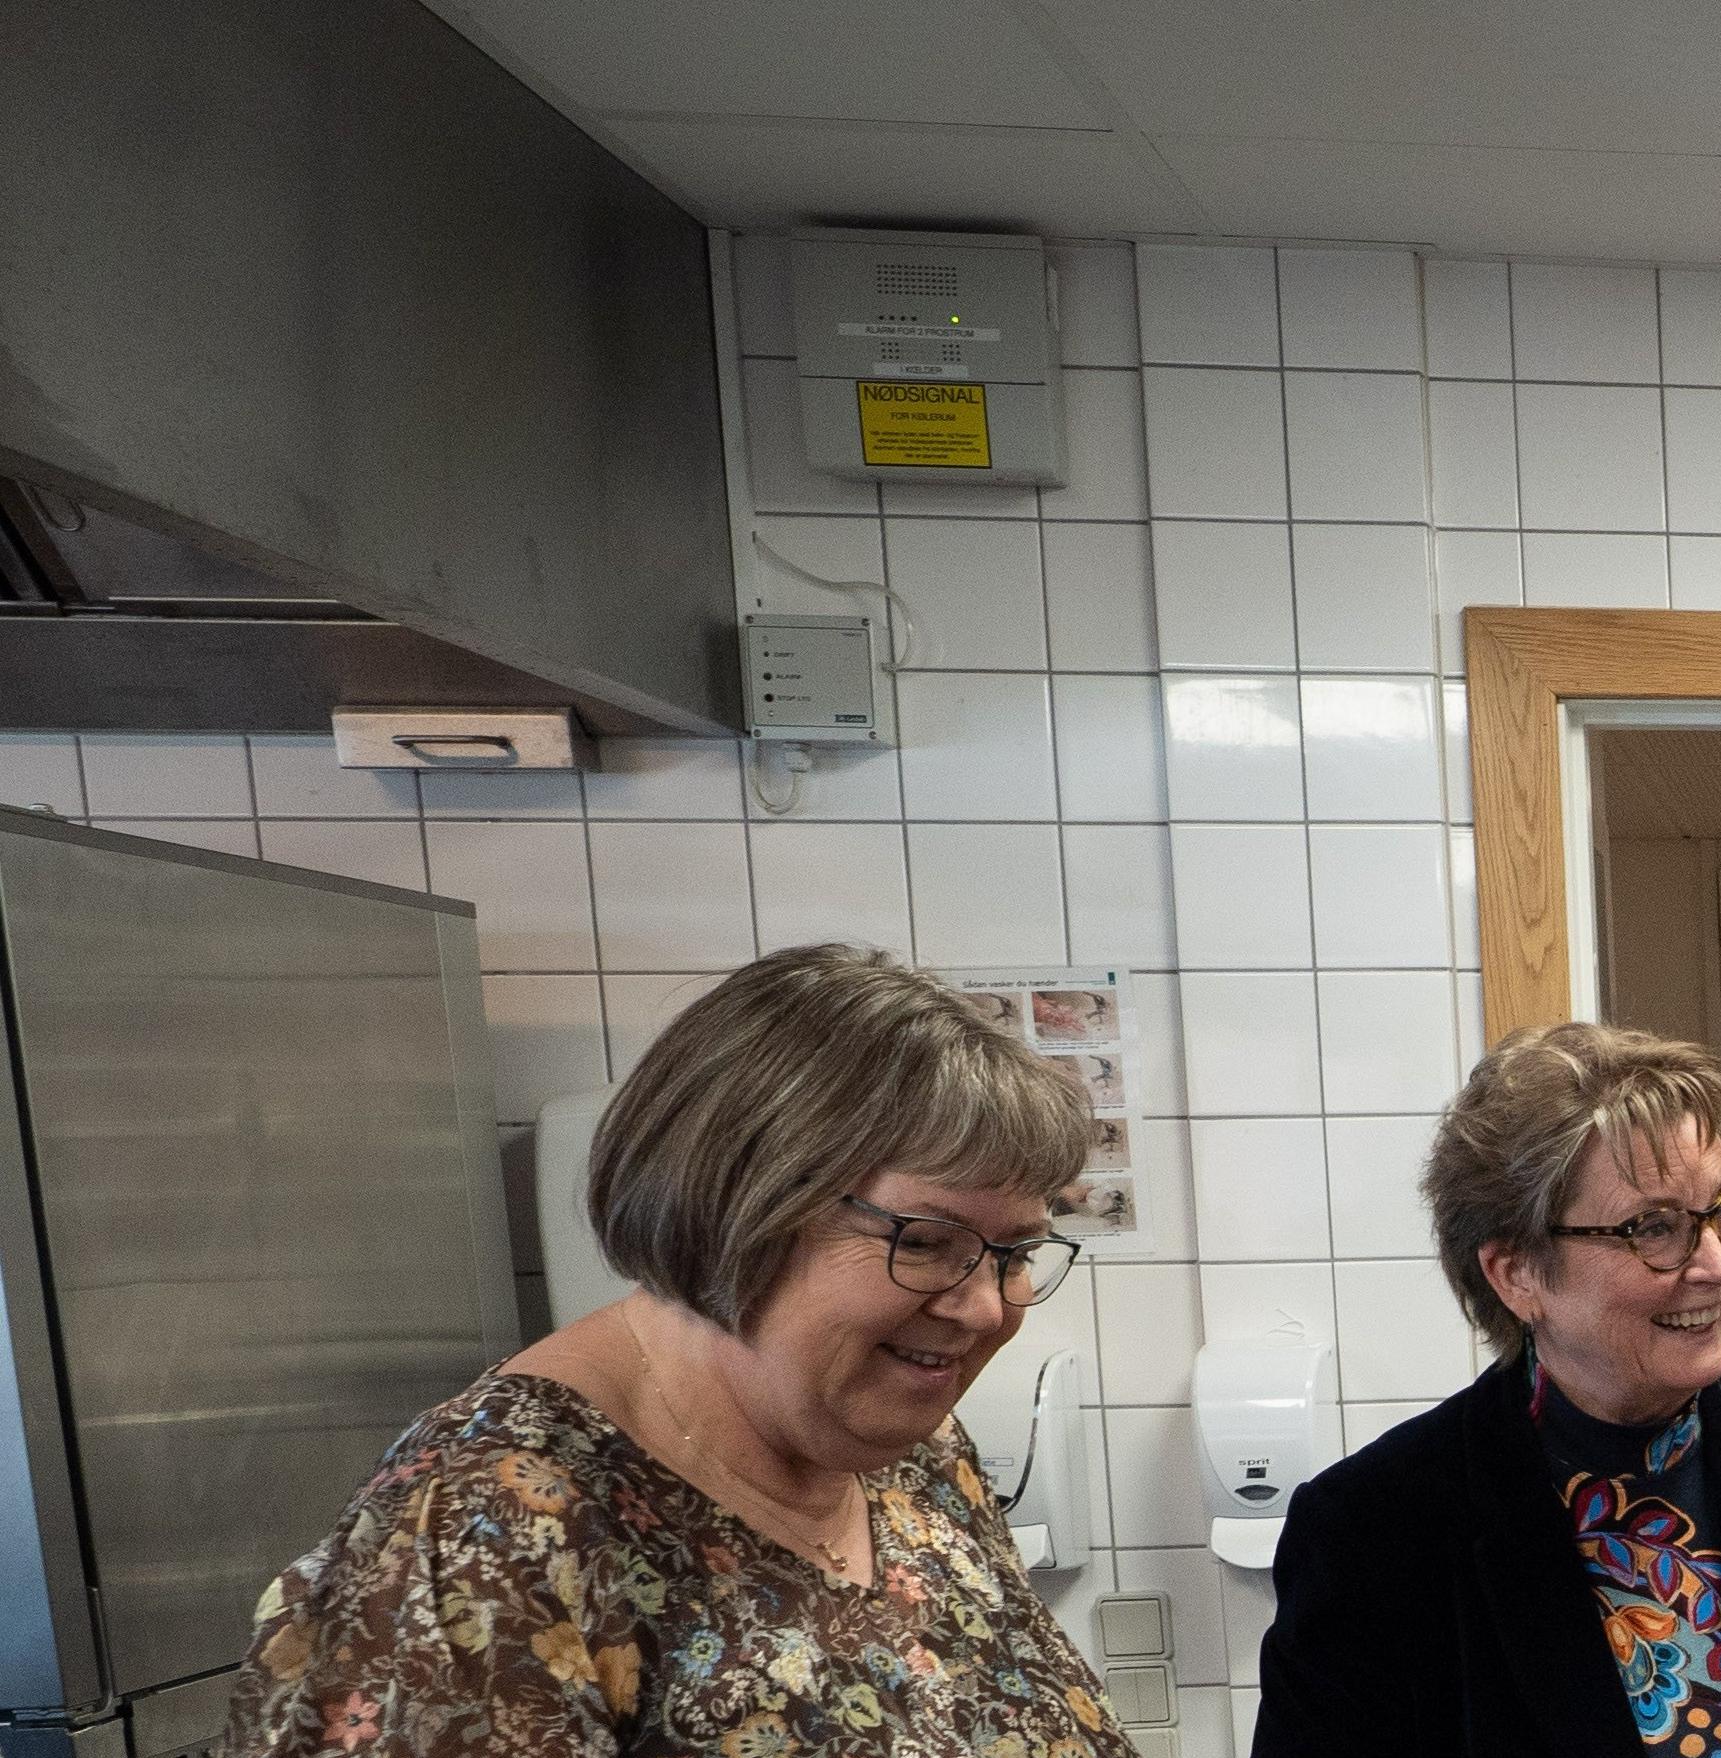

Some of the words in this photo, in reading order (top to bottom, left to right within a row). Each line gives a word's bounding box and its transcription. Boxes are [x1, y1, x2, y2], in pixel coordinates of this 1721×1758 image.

[863, 385, 980, 404] NØDSIGNAL
[890, 412, 909, 420] FOR
[1238, 1458, 1271, 1466] sprit
